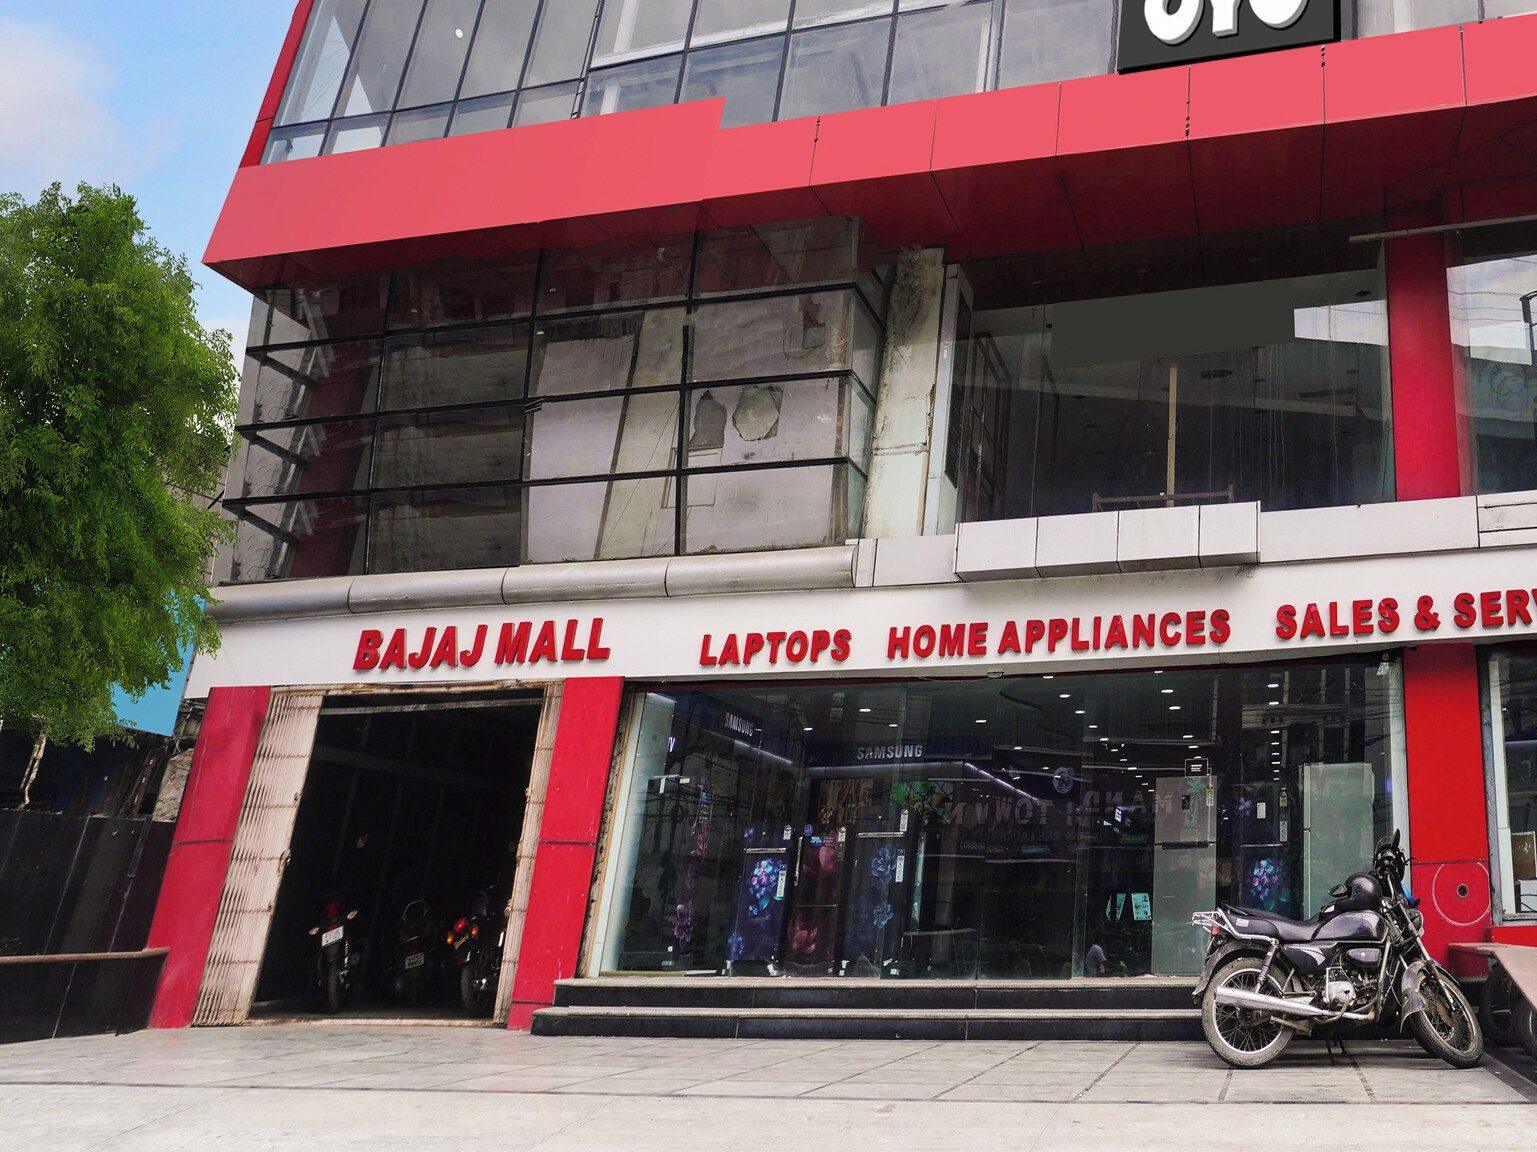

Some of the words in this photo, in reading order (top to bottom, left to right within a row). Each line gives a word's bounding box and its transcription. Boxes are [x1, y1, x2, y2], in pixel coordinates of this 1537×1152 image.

[699, 628, 852, 667] LAPTOPS
[887, 621, 988, 660] HOME
[998, 608, 1232, 654] APPLIANCES
[1275, 597, 1400, 640] SALES
[1414, 595, 1441, 631] &
[353, 624, 488, 673] BAJAJ
[494, 617, 611, 665] MALL
[724, 711, 754, 737] SAMSUNG
[857, 744, 924, 761] SAMSUNG
